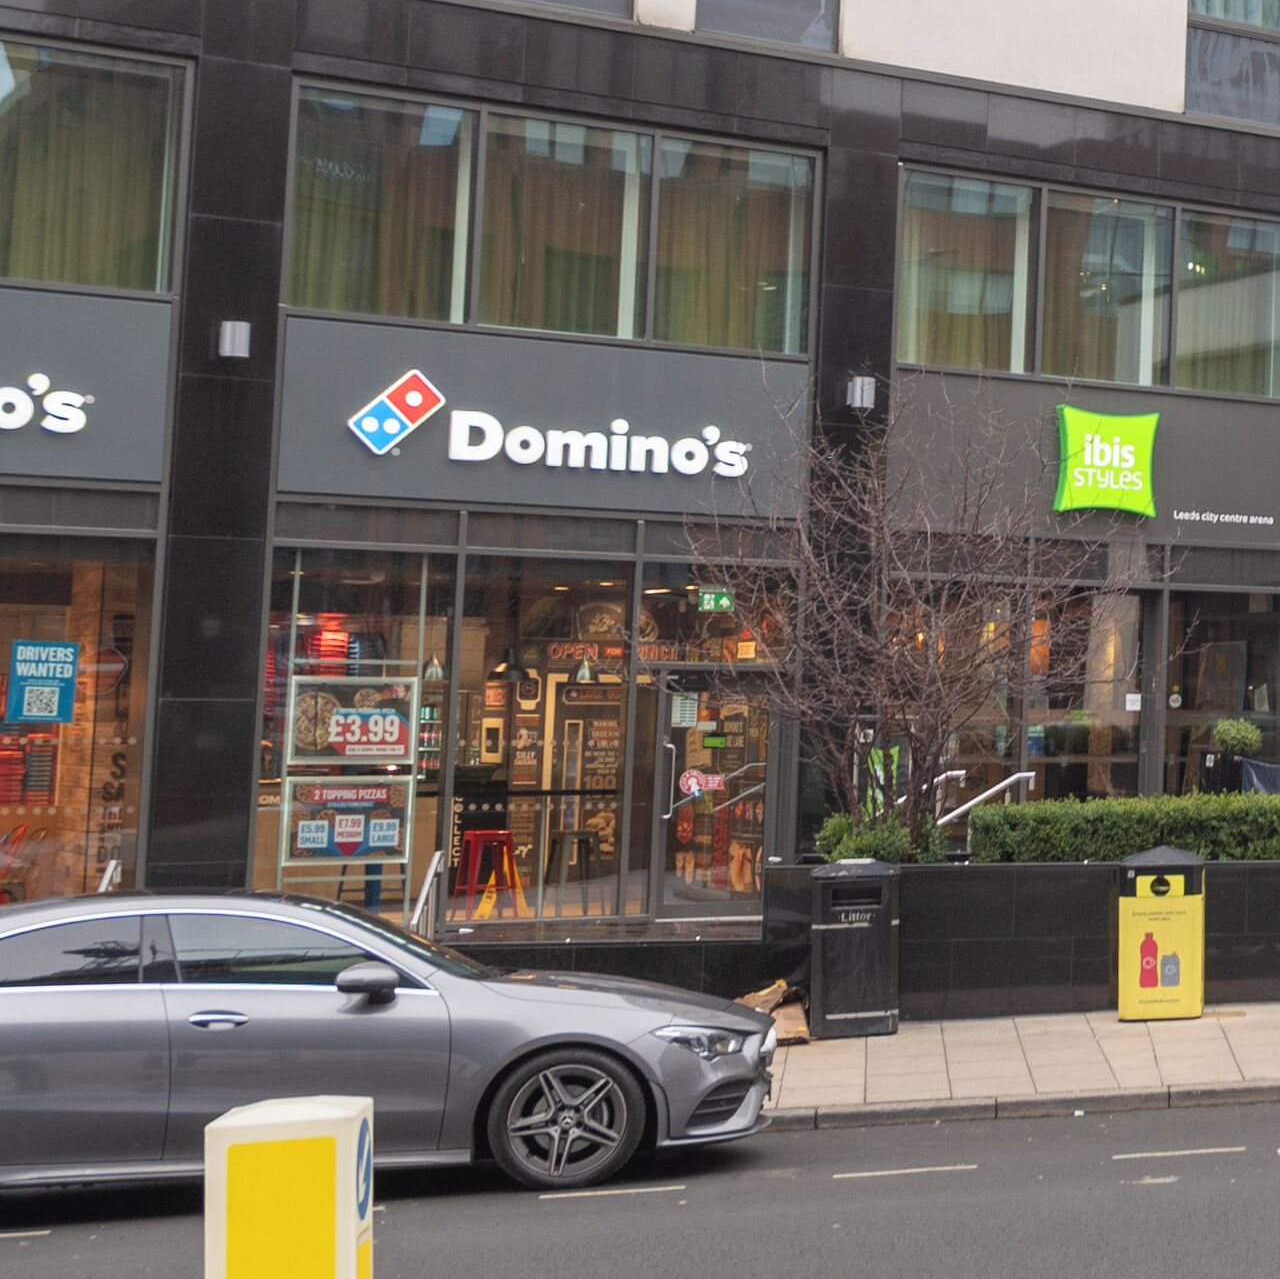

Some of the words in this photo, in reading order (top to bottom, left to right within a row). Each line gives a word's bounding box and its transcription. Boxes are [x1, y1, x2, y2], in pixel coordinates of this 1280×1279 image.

[449, 410, 749, 478] Domino's
[1083, 433, 1136, 469] ibis
[1173, 509, 1200, 521] Leeds
[1201, 511, 1219, 524] city
[1219, 513, 1249, 523] centre
[1249, 515, 1275, 525] arena
[16, 645, 75, 662] DRIVERS
[547, 641, 599, 660] OPEN
[16, 662, 73, 678] WANTED
[327, 714, 400, 743] £3.99
[313, 790, 322, 801] 2
[322, 789, 357, 801] TOPPING
[357, 788, 388, 800] PIZZAS
[301, 823, 327, 834] £5.99
[338, 818, 362, 829] £7.99
[372, 822, 397, 832] £9.99
[300, 834, 326, 845] SMALL
[336, 829, 362, 838] MEDIUM
[371, 833, 396, 843] LARGE
